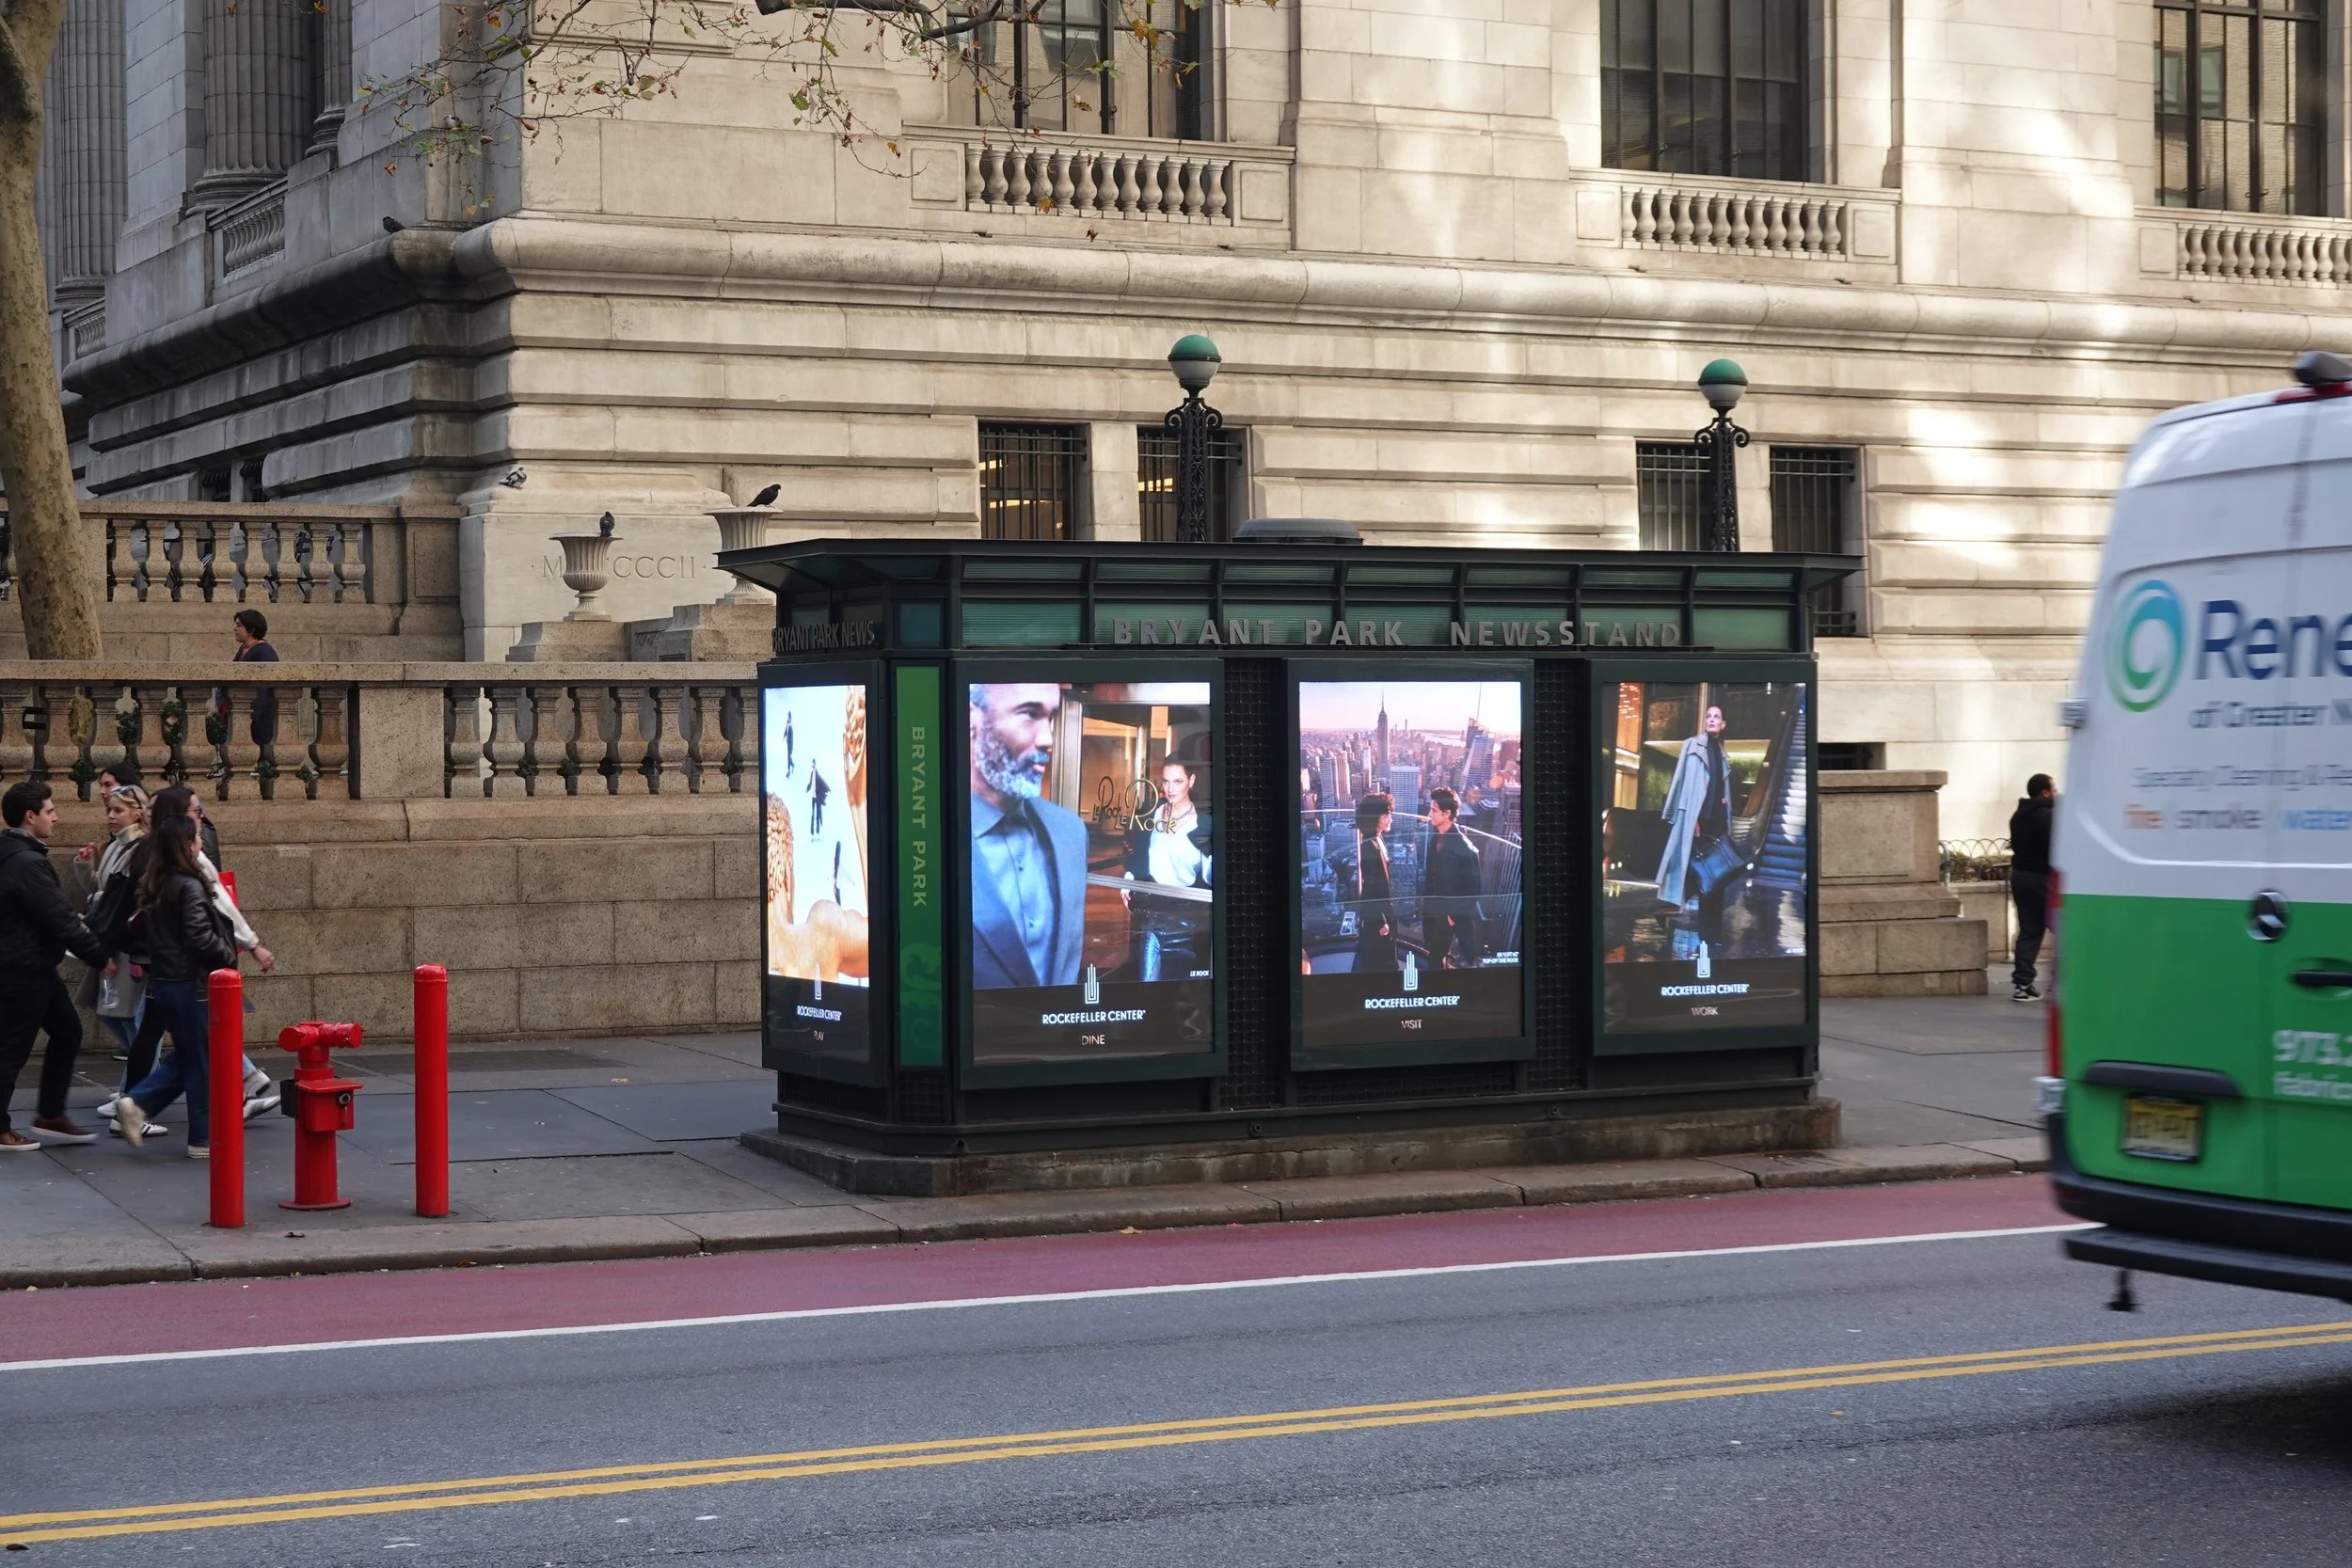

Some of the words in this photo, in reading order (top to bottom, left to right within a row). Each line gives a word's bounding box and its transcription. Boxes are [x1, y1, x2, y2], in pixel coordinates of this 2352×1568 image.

[542, 555, 695, 579] MCCCII
[771, 626, 809, 652] BRYANT
[813, 623, 839, 649] PARK
[842, 620, 875, 647] NEWS
[1113, 619, 1274, 645] BRYANT
[1304, 620, 1404, 646] PARK
[1450, 621, 1682, 646] NEWSSTAND
[912, 726, 926, 828] BRYANT
[913, 841, 927, 907] PARK
[1661, 985, 1716, 996] ROCKEFELLER
[1716, 983, 1748, 994] CENTER
[1365, 997, 1424, 1008] ROCKEFELLER
[1424, 995, 1459, 1006] CENTER
[797, 1005, 825, 1019] ROCKEFELLER
[824, 1008, 842, 1022] CENTER
[1042, 1010, 1106, 1024] ROCKEFELLER
[1107, 1008, 1145, 1022] CENTER
[1691, 1006, 1719, 1016] WORK
[1401, 1019, 1422, 1030] VISIT
[814, 1030, 824, 1041] PLAY
[1081, 1034, 1105, 1045] DINE
